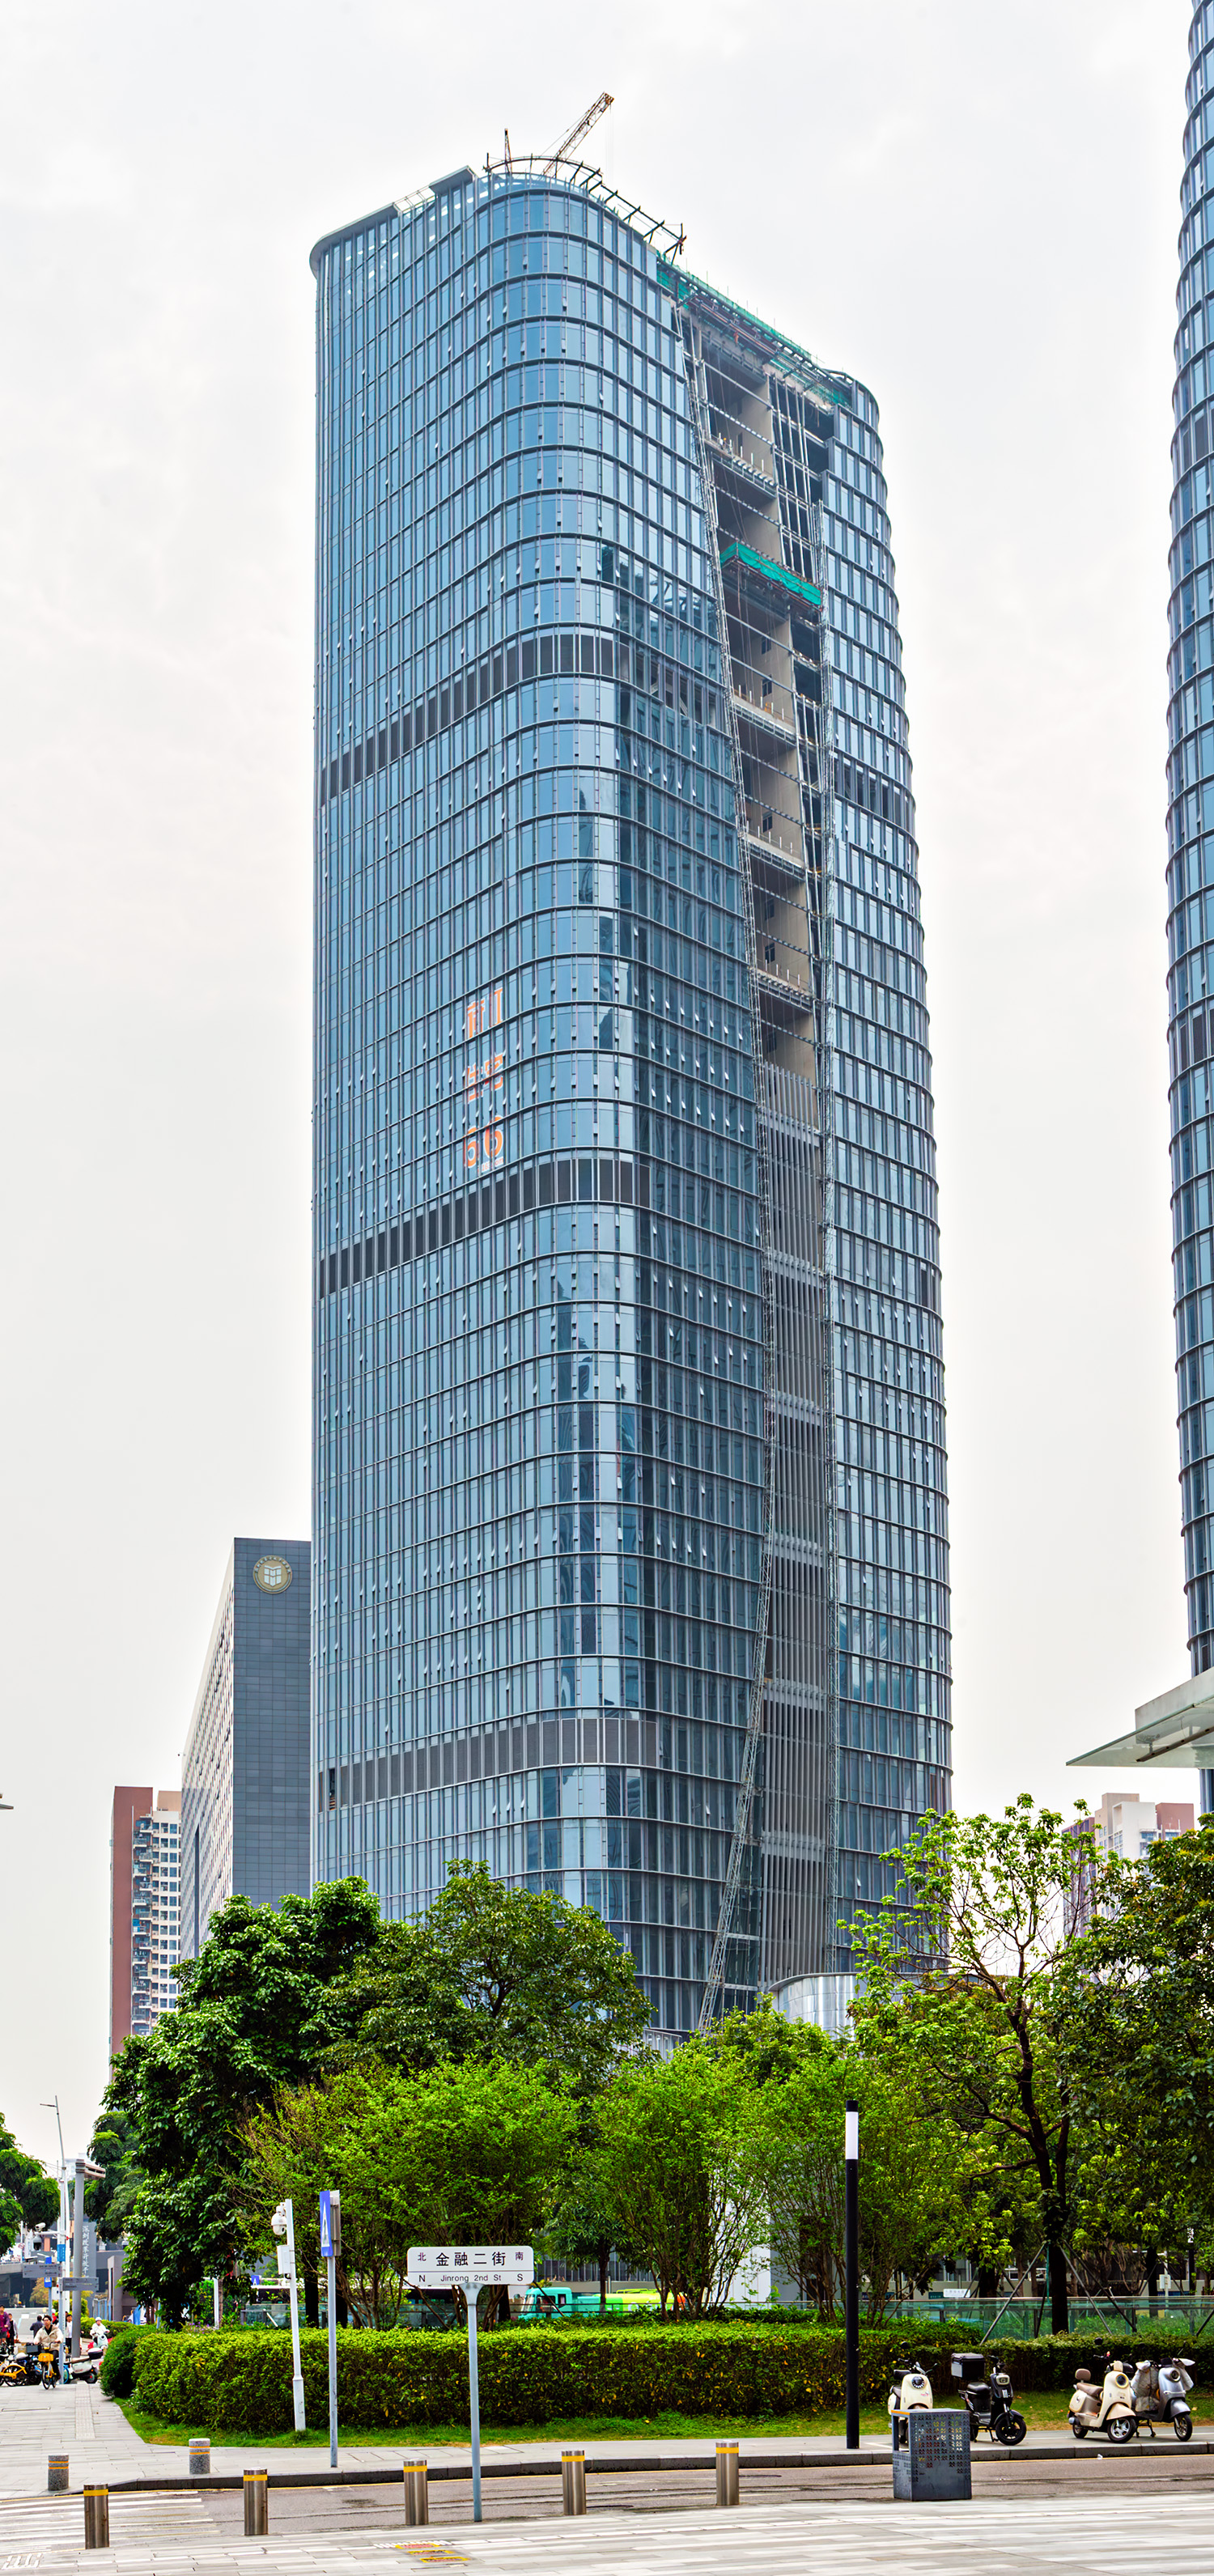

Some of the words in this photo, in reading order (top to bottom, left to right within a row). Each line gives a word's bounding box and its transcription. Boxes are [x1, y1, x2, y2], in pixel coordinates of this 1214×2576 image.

[82, 2225, 90, 2278] 深圳改革开放干
[418, 2252, 427, 2261] 北
[435, 2251, 506, 2266] 金融二街
[516, 2251, 523, 2260] 南
[440, 2274, 469, 2283] Jinrong
[516, 2273, 524, 2281] S
